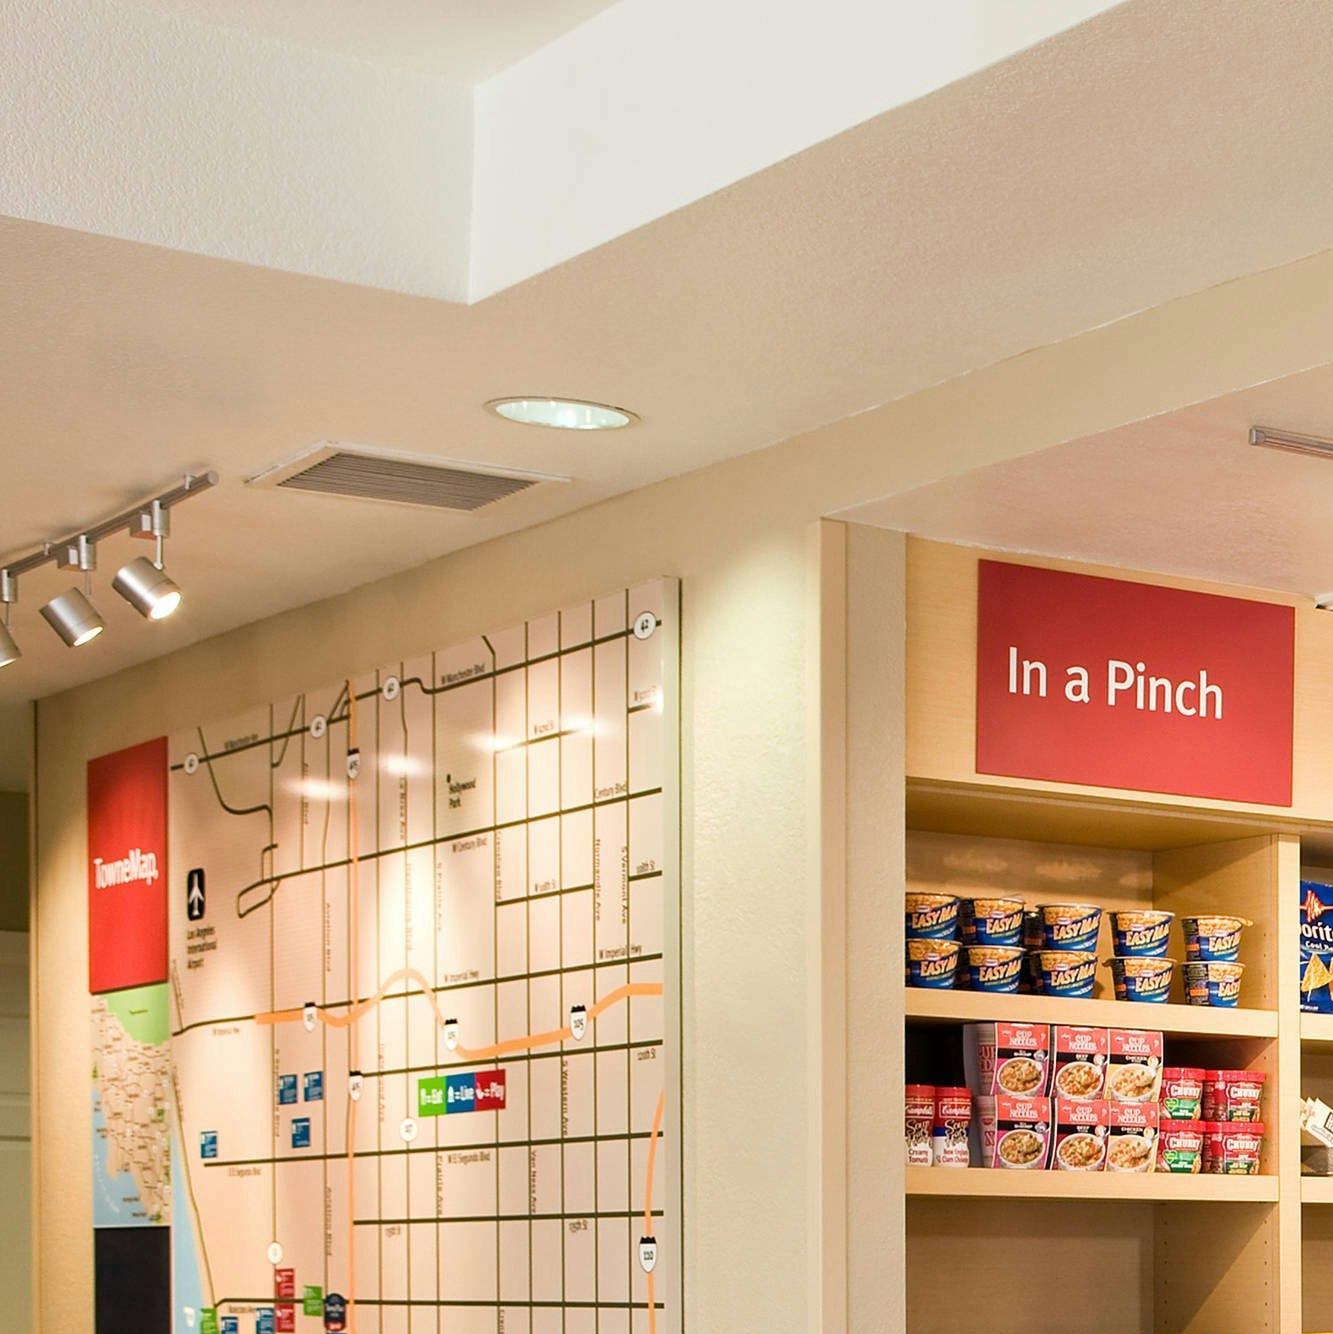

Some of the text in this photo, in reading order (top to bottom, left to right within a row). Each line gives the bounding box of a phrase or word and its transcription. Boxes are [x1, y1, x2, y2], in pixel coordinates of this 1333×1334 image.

[1009, 646, 1224, 720] In a Pinch
[911, 911, 938, 928] EASY
[986, 917, 1011, 933] EASY
[1053, 924, 1079, 940] EASY
[1126, 930, 1152, 946] EASY
[1209, 936, 1233, 951] EASY
[921, 959, 946, 976] EASY
[979, 966, 1005, 982] EASY
[1051, 969, 1078, 986] EASY
[1136, 976, 1161, 992] EASY
[1016, 1030, 1032, 1041] CUP
[1075, 1035, 1092, 1046] CUP
[1128, 1038, 1145, 1048] CUP
[1016, 1103, 1033, 1113] CUP
[1076, 1106, 1092, 1117] CUP
[1124, 1108, 1141, 1119] CUP
